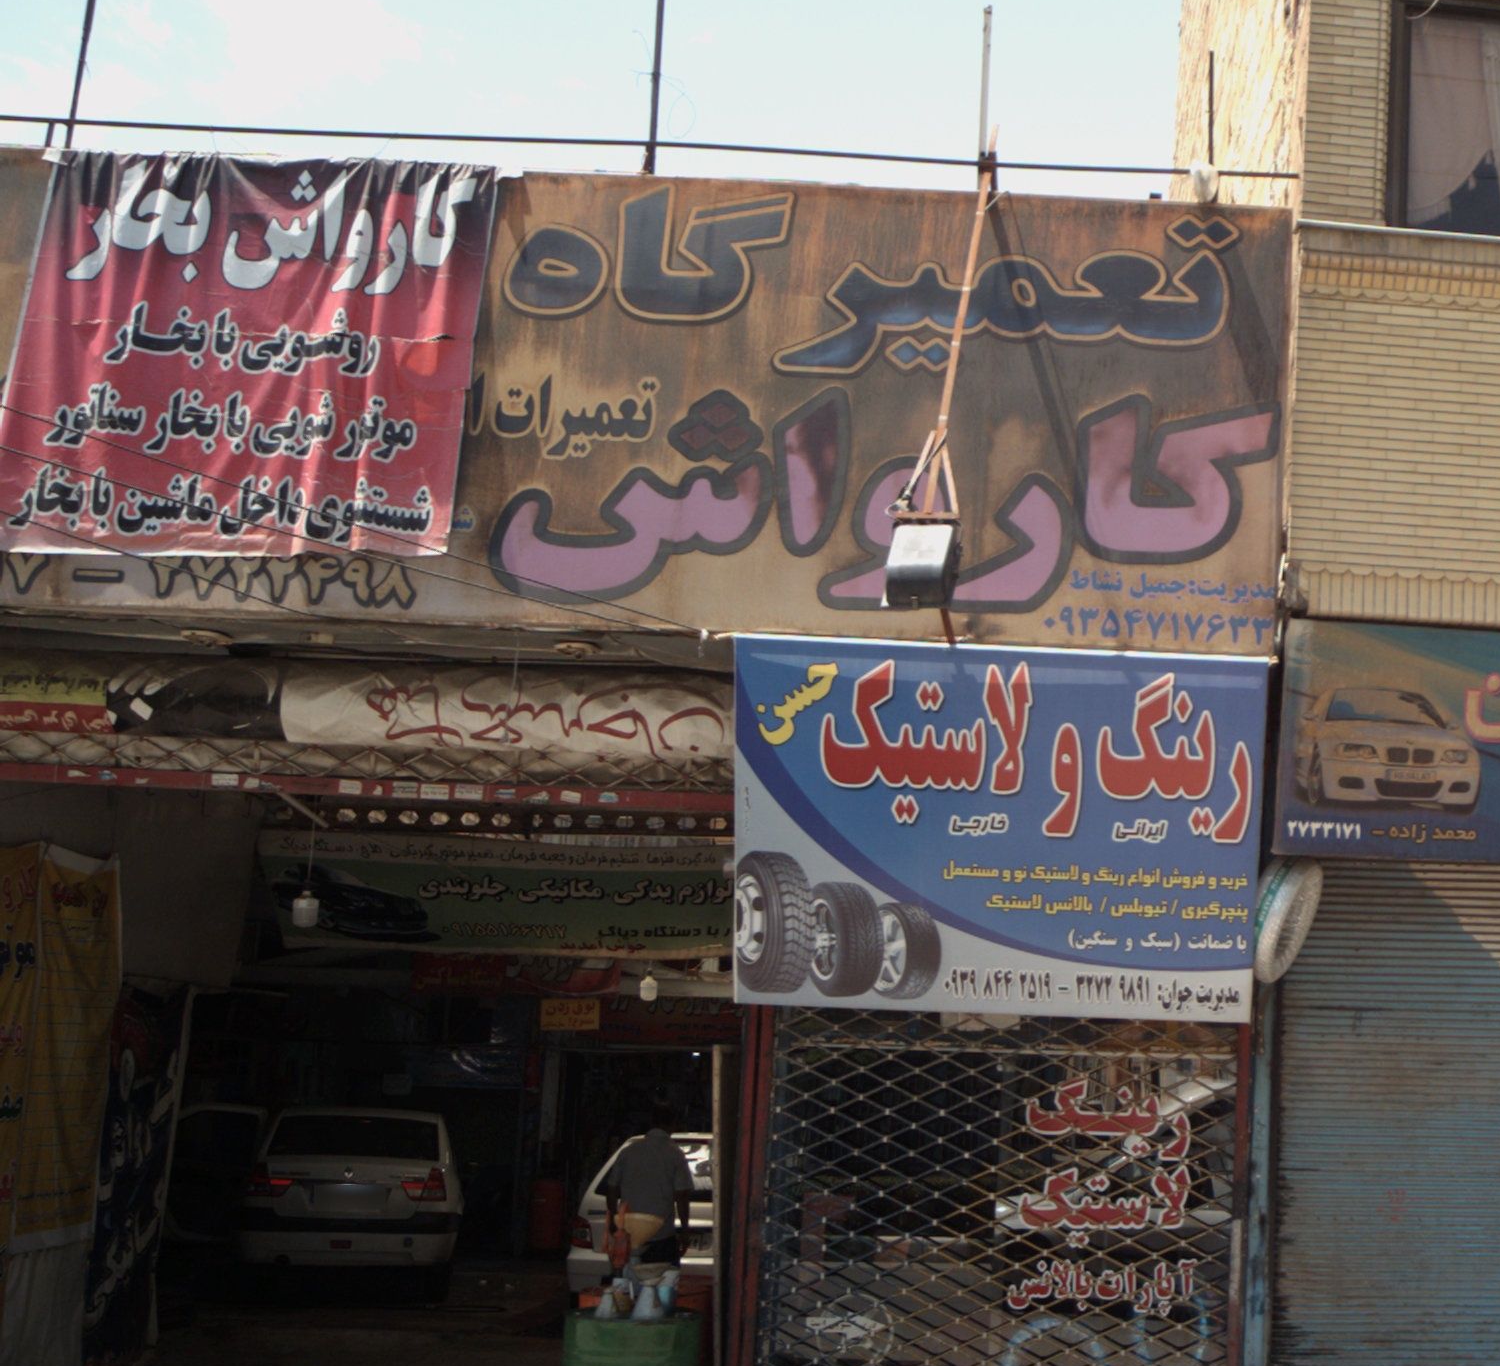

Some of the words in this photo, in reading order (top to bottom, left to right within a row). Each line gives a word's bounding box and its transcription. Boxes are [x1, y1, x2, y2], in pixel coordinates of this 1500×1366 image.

[66, 159, 211, 284] بخار
[222, 169, 478, 295] کارواش
[503, 184, 795, 323] گاه
[772, 212, 1241, 378] تعمیر
[211, 309, 240, 372] با
[240, 307, 380, 377] روشویی
[144, 389, 221, 455] بخار
[222, 391, 250, 454] با
[491, 371, 661, 461] تعمیرات
[8, 463, 85, 531] بخار
[89, 467, 114, 529] با
[116, 473, 214, 535] ماشین
[219, 475, 303, 538] داخل
[489, 387, 1284, 612] کارواش
[1070, 569, 1123, 592] نشاط
[1130, 572, 1186, 600] جمیل
[1043, 605, 1275, 645] ۰۹۳۵۴۷۱۷۶۳۳
[756, 661, 839, 746] حسن
[820, 659, 1033, 824] لاستیک
[1097, 672, 1253, 843] رینگ
[1043, 722, 1083, 838] و
[949, 812, 1009, 838] خارجی
[1112, 819, 1168, 842] ایرانی
[1390, 824, 1426, 844] زاده
[1431, 826, 1477, 841] محمد
[943, 860, 999, 880] مستعمل
[1002, 870, 1011, 882] و
[1013, 866, 1027, 883] نو
[1029, 864, 1078, 884] لاستیک
[1081, 872, 1090, 885] و
[1094, 866, 1124, 886] رینگ
[1127, 867, 1160, 888] انواع
[1162, 867, 1205, 889] فروش
[1207, 875, 1217, 889] و
[1220, 872, 1248, 889] خرید
[517, 877, 604, 904] مکانیکی
[612, 879, 672, 905] یدکی
[985, 893, 1041, 912] لاستیک
[1045, 894, 1093, 915] بالانس
[1125, 937, 1134, 952] و
[1187, 932, 1233, 951] ضمانت
[1236, 934, 1247, 953] با
[1196, 984, 1240, 1011] مدیریت
[1019, 1165, 1191, 1247] لاستیک
